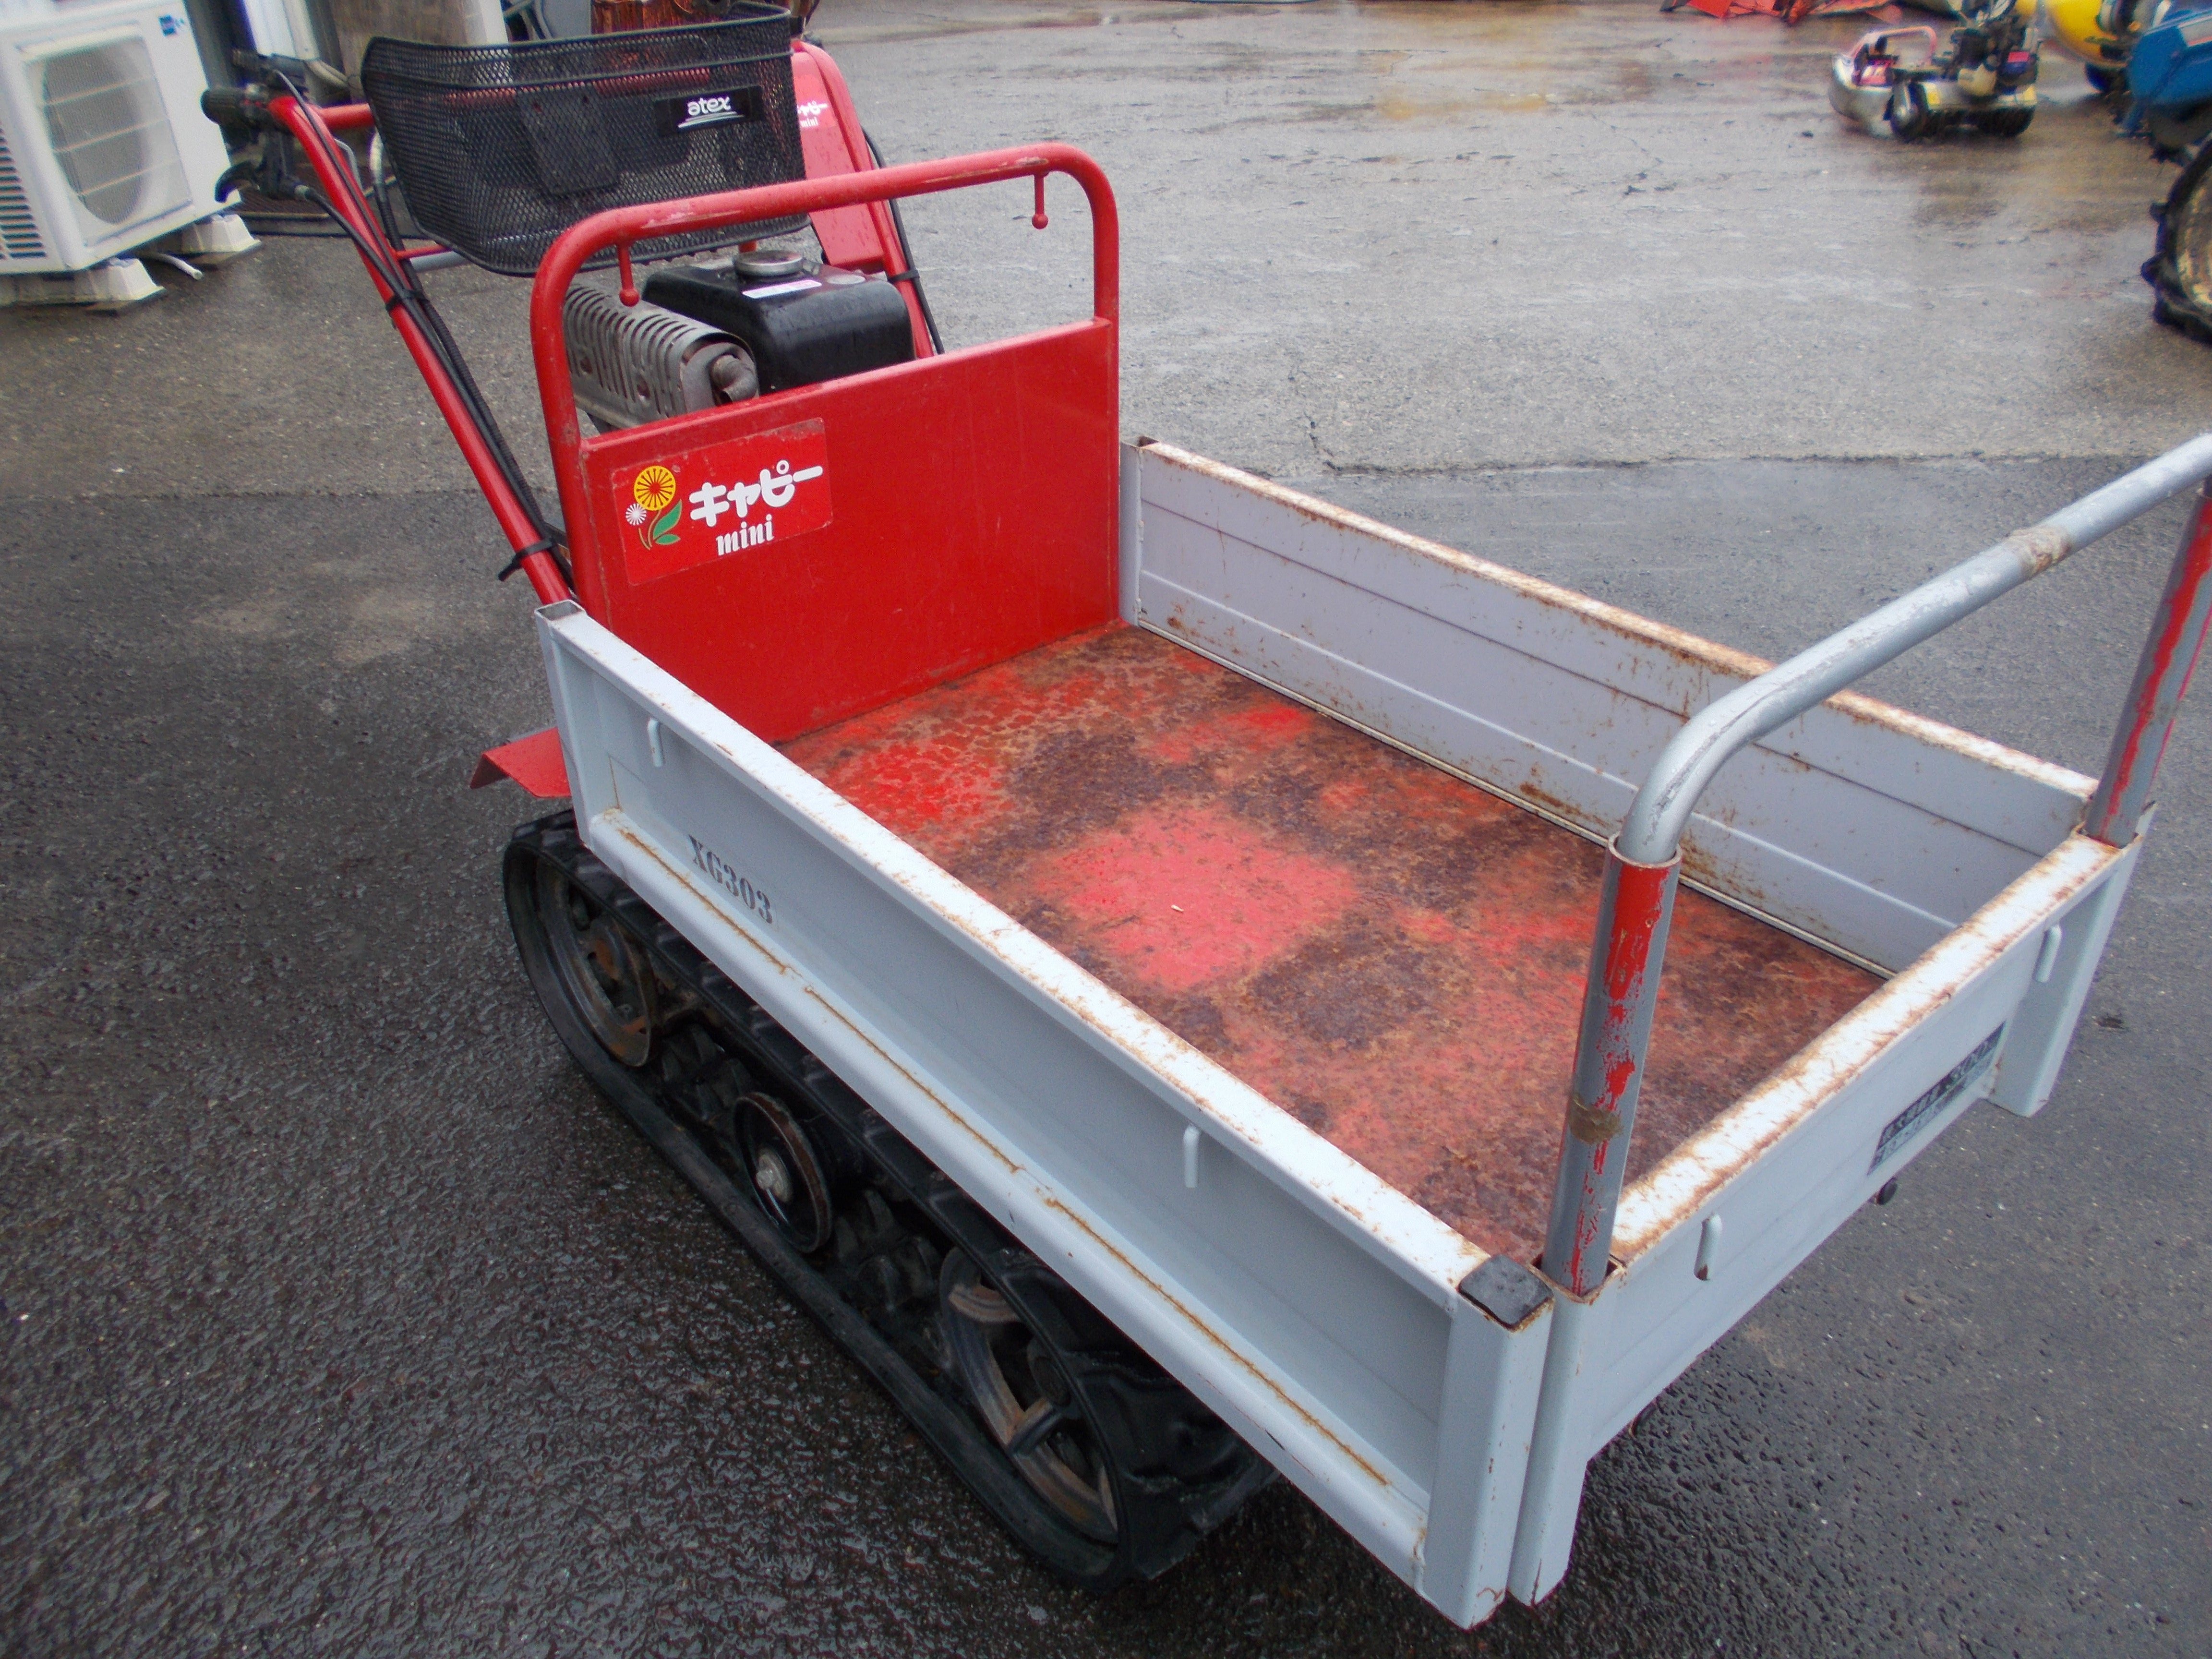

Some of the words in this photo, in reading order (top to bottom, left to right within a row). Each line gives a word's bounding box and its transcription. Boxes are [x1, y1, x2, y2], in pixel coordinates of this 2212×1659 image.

[687, 96, 731, 116] atex
[800, 117, 819, 128] mini
[689, 459, 823, 527] キャピー
[715, 514, 774, 556] mini
[688, 834, 773, 924] XG303
